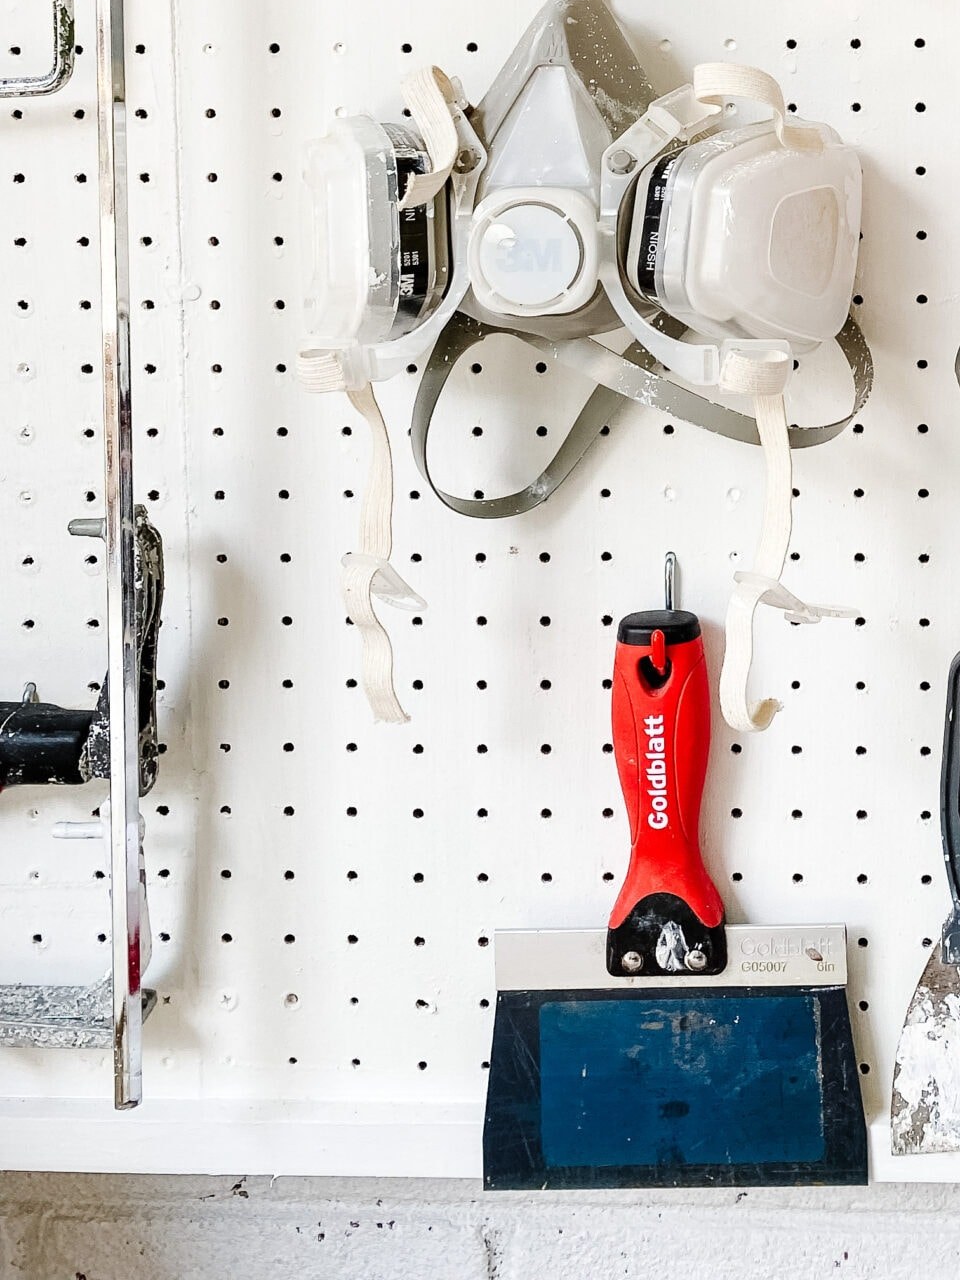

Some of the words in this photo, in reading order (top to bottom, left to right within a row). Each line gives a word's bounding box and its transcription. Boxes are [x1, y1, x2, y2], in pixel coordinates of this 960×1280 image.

[646, 232, 659, 270] NIOSH
[400, 274, 414, 296] 3M
[644, 715, 668, 829] Goldblatt
[742, 961, 786, 972] G05007
